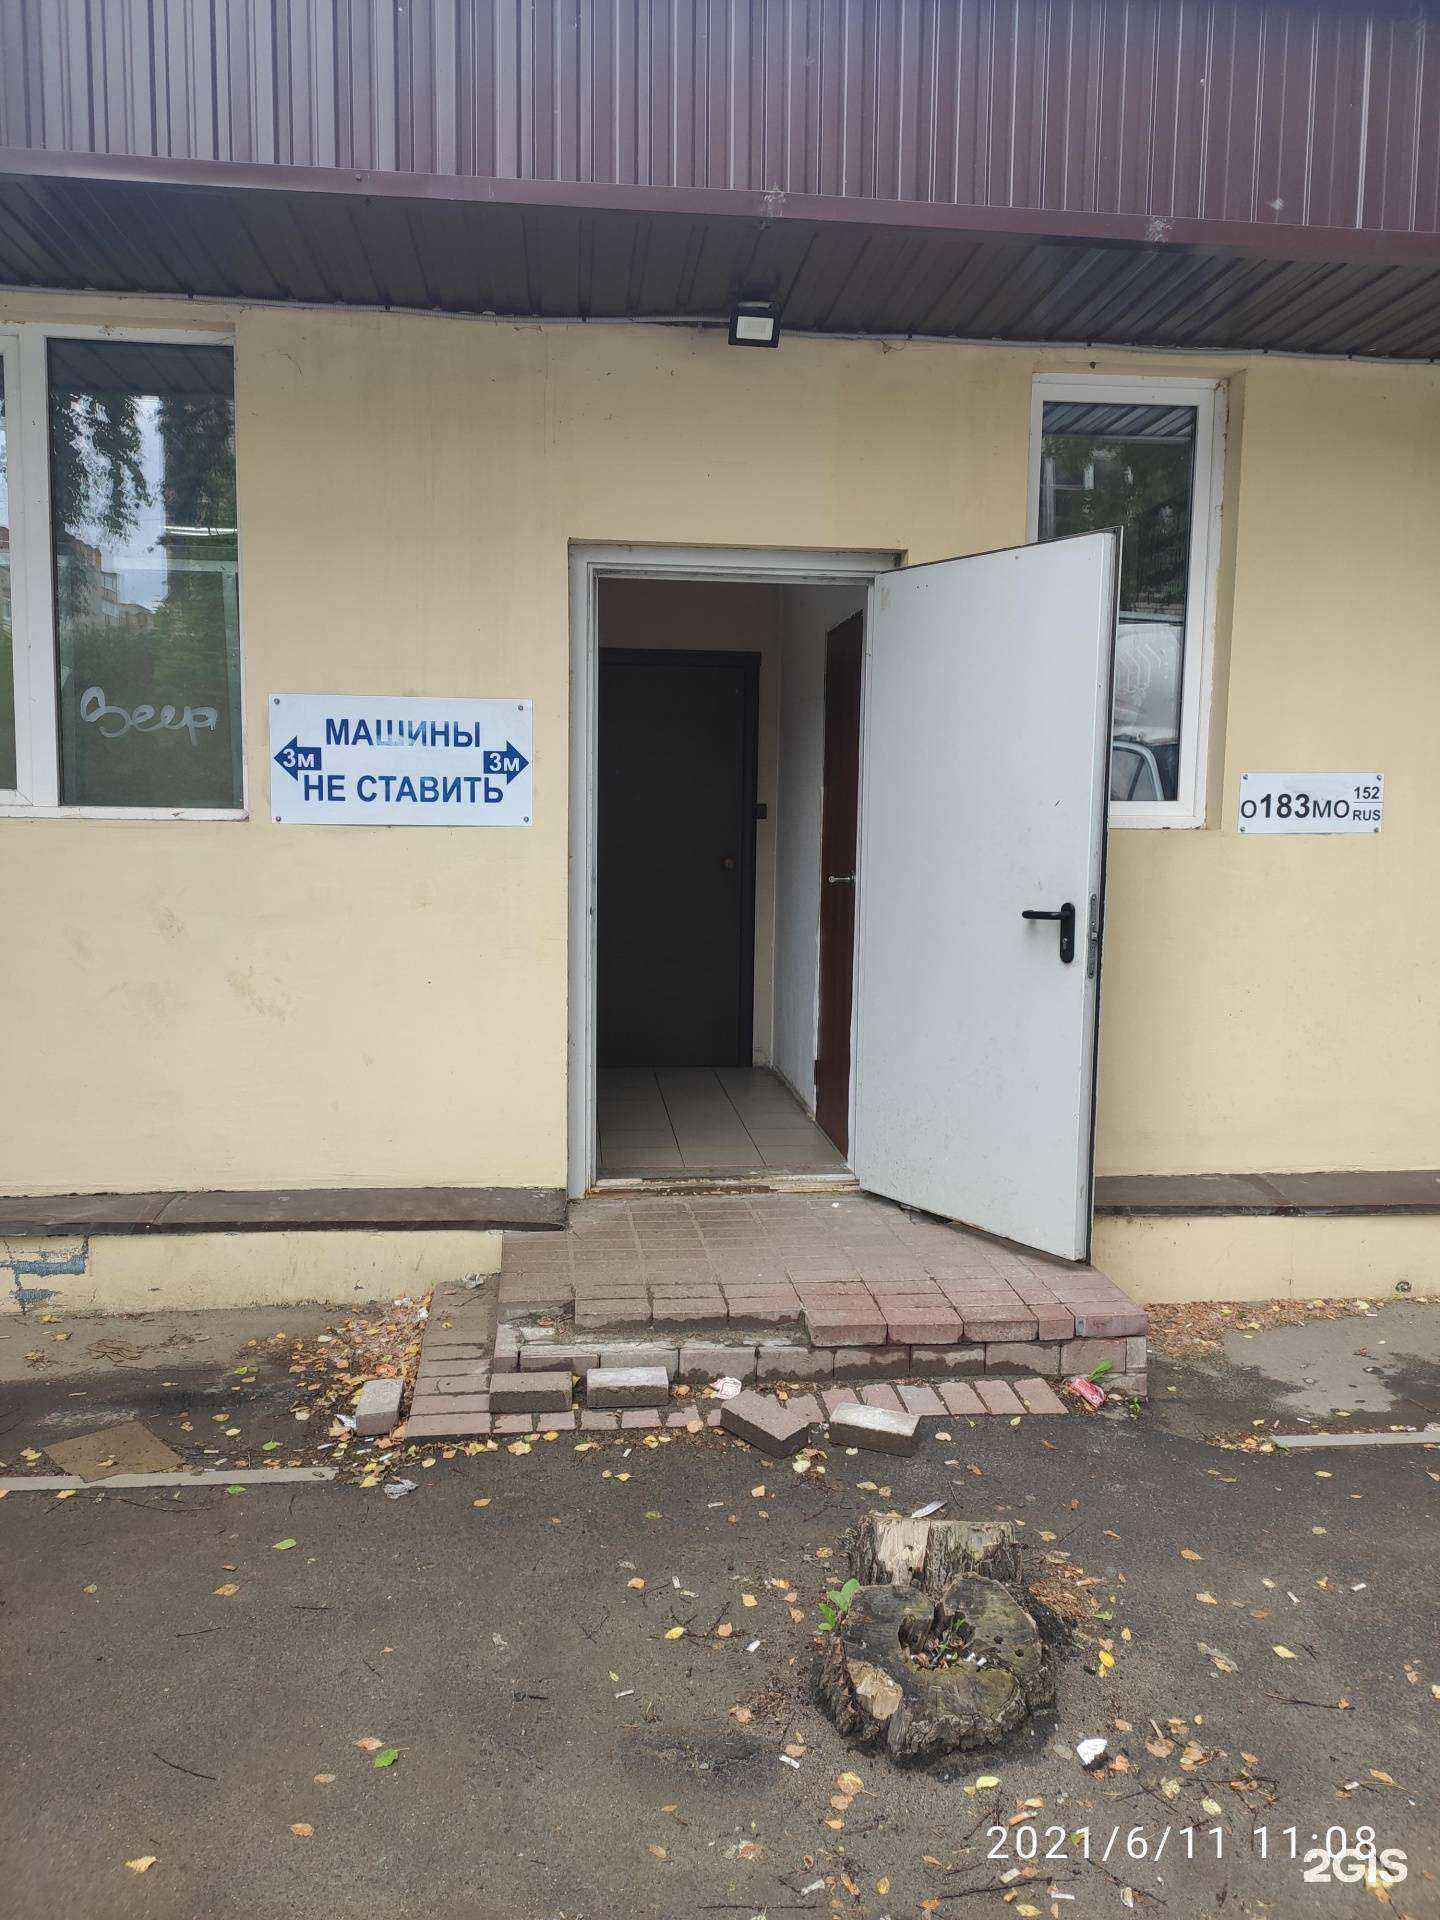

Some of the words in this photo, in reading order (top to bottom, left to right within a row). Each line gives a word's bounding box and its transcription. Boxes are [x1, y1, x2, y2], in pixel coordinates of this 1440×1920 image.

[325, 718, 480, 748] МАШИНЫ
[303, 774, 346, 802] НЕ
[356, 775, 504, 803] СТАВИТЬ
[1354, 786, 1380, 800] 152
[1352, 809, 1381, 821] RUS
